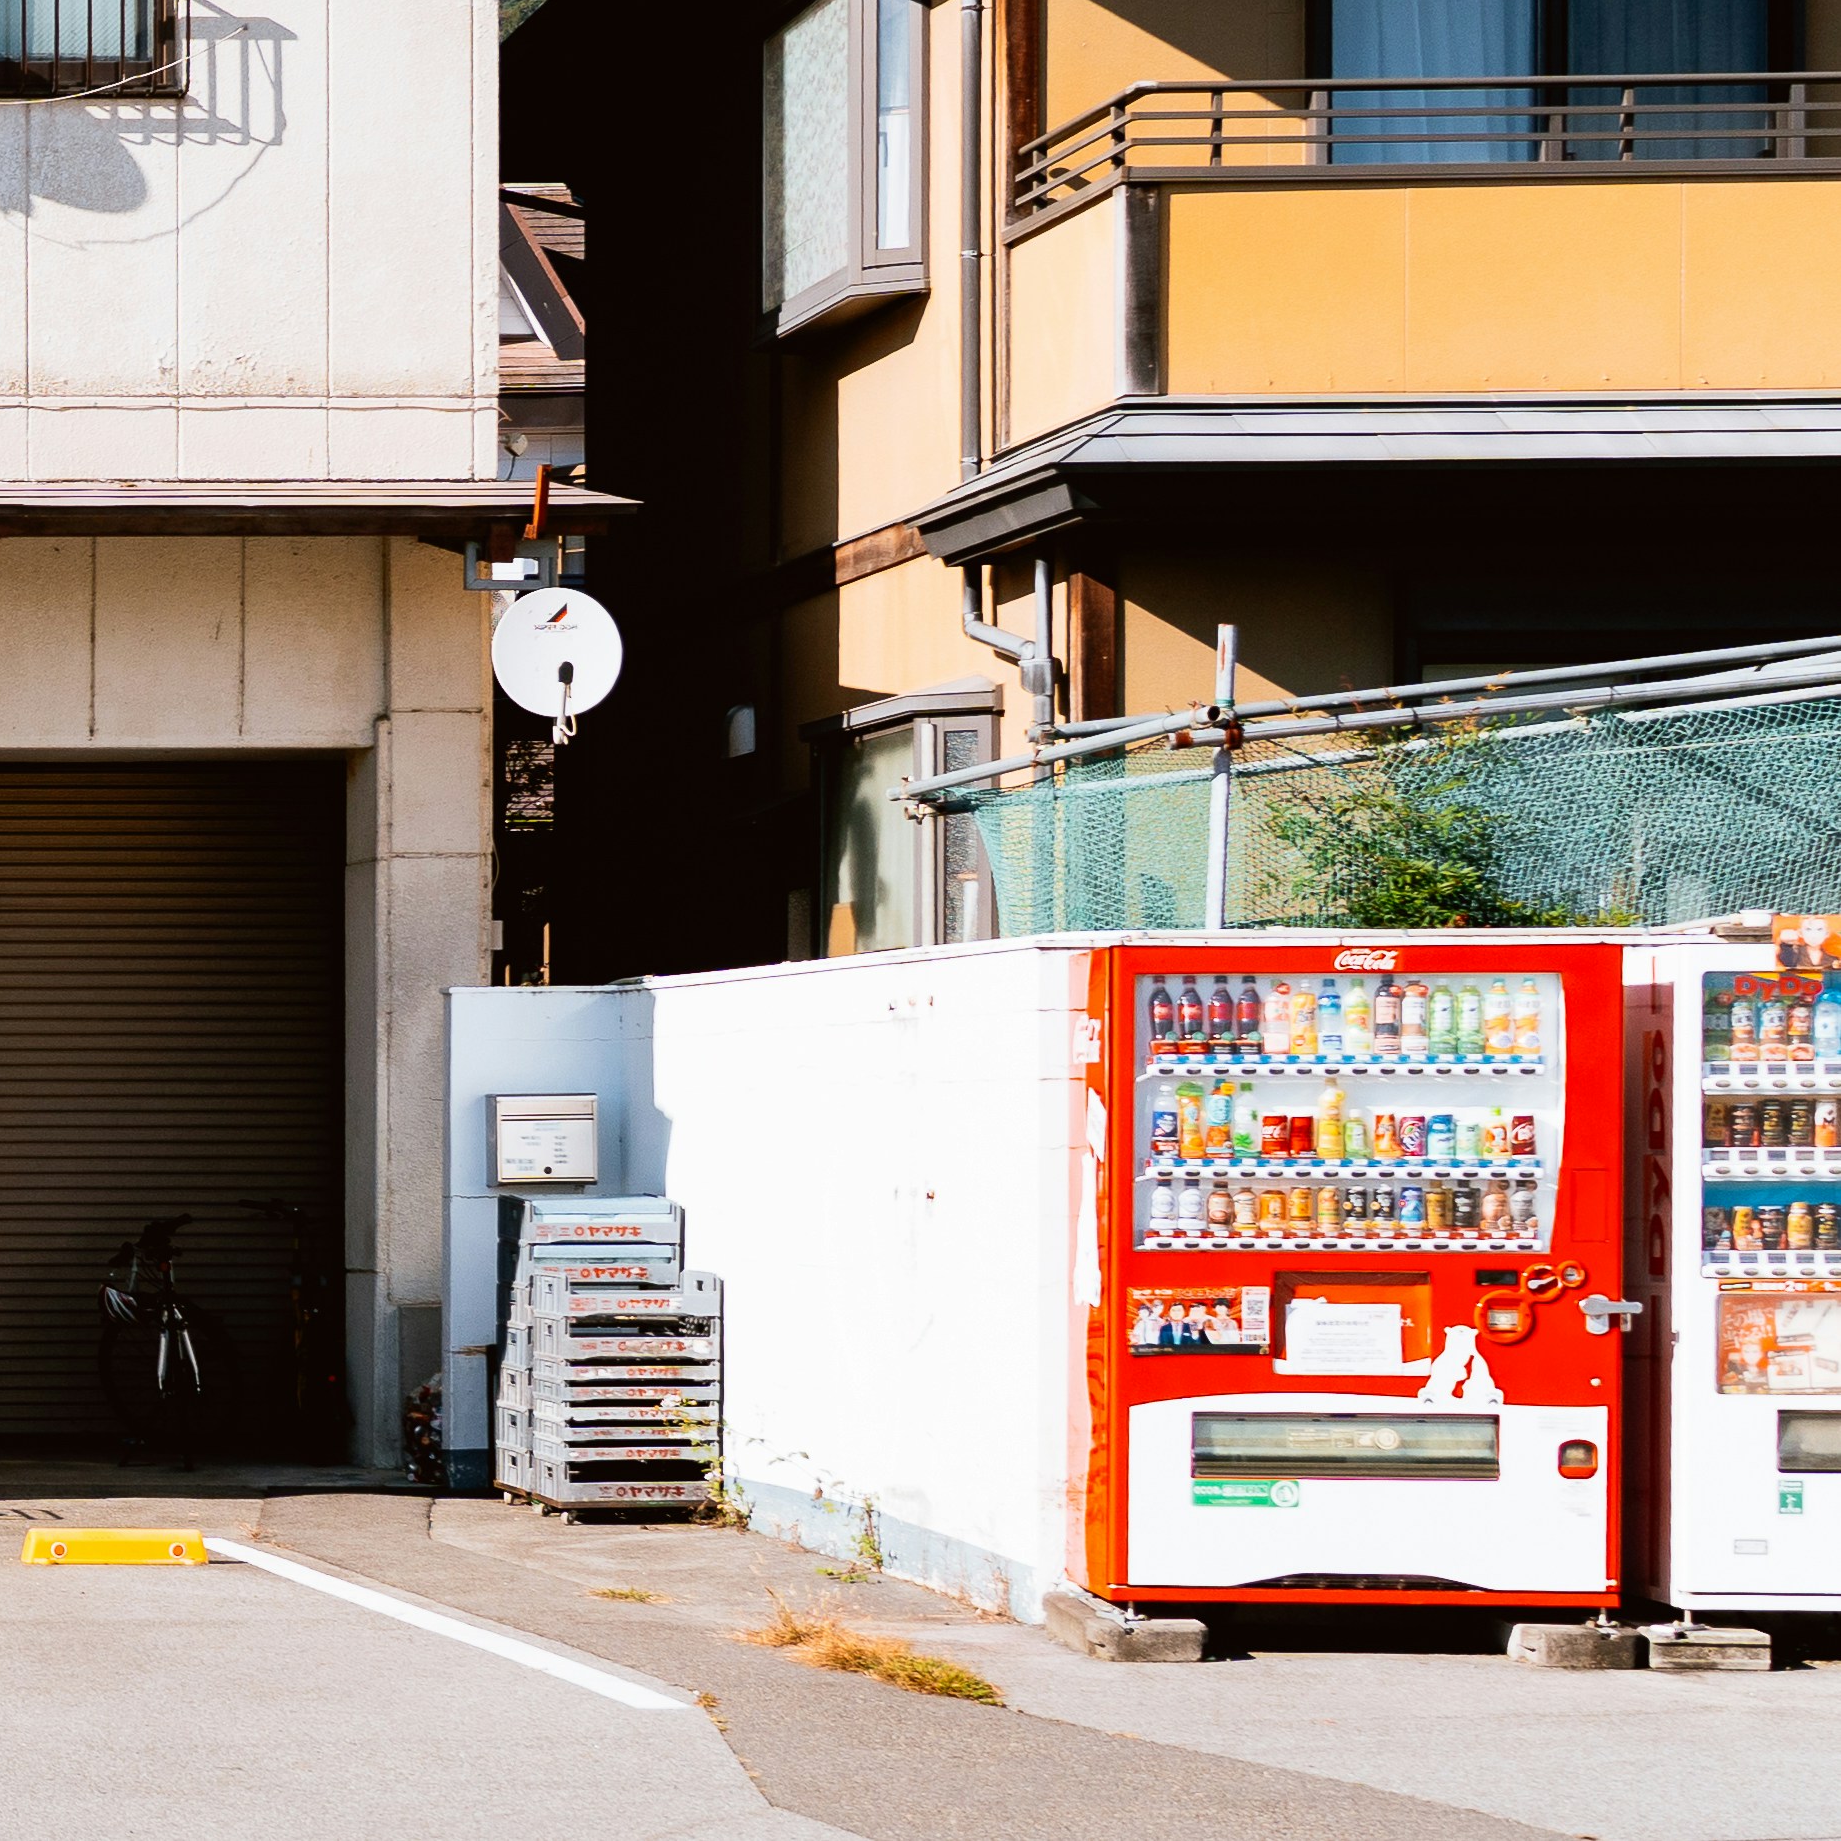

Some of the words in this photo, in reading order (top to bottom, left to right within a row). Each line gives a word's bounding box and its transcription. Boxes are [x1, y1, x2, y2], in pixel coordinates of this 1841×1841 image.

[587, 1226, 642, 1237] ヤマザキ
[629, 1486, 686, 1497] ヤマザキ
